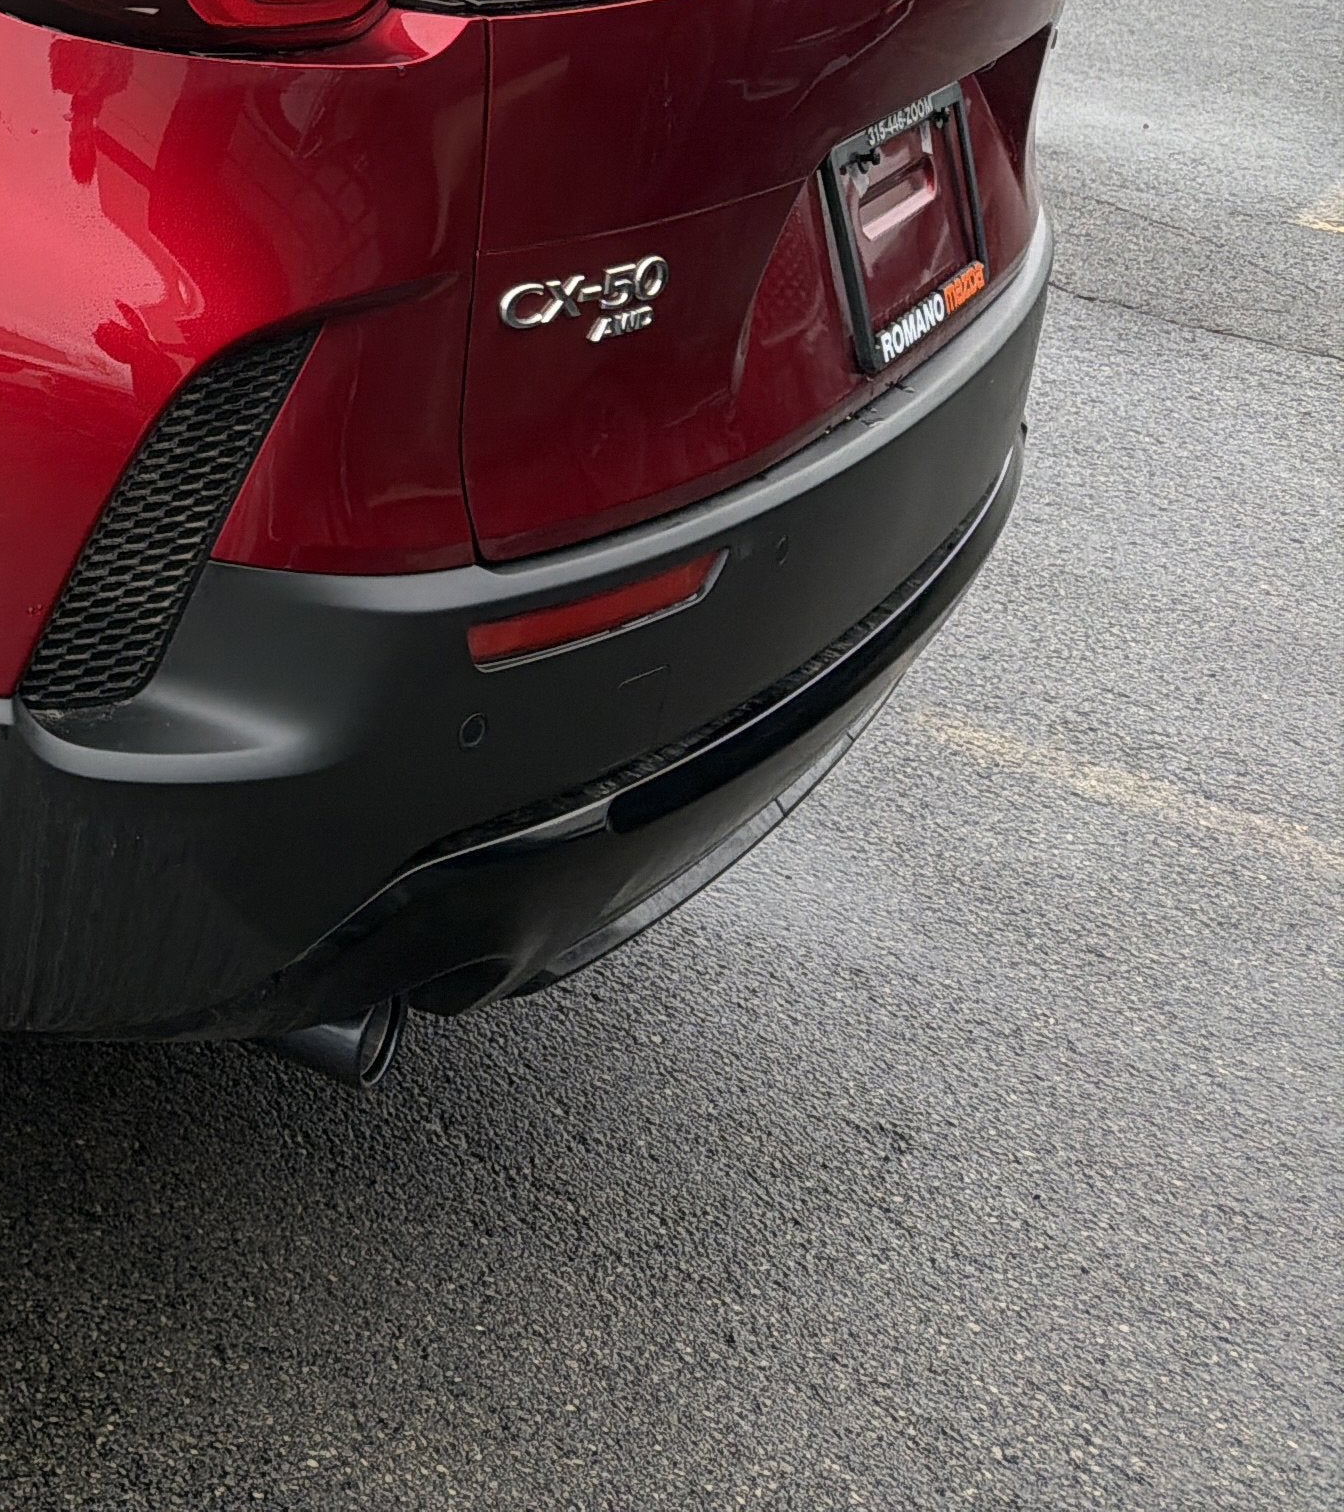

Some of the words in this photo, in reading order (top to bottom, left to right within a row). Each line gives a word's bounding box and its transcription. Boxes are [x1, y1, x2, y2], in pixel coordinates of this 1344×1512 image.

[867, 95, 933, 146] 315-446-ZOOM
[500, 255, 669, 329] CX-50
[586, 305, 654, 343] AWD
[881, 293, 945, 363] ROMANO
